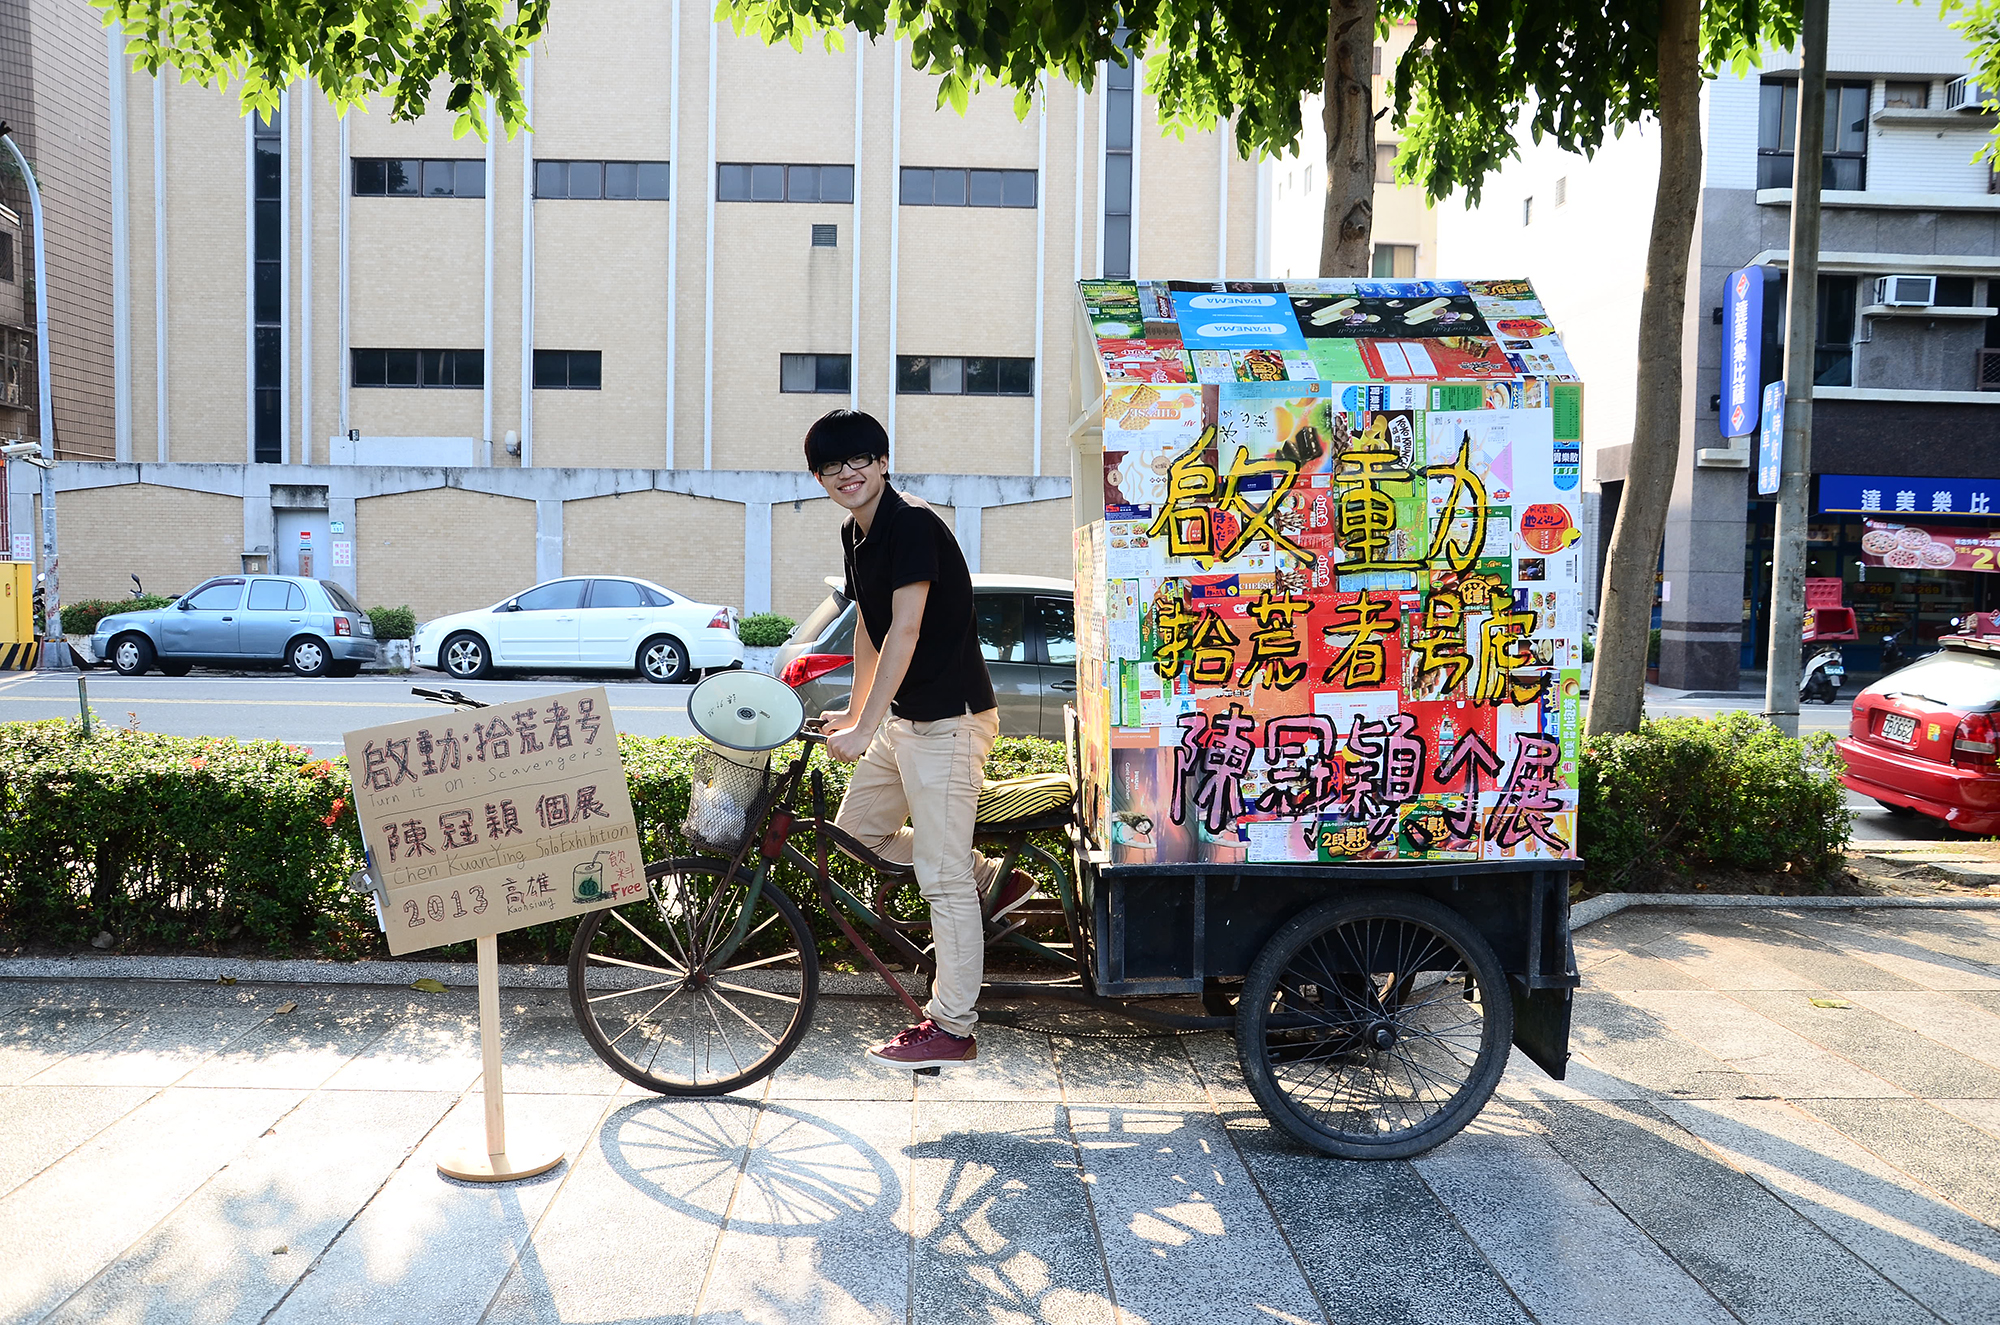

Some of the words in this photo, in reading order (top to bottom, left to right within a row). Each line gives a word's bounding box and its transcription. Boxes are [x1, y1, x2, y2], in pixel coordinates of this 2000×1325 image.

[368, 793, 400, 808] Turn
[412, 786, 425, 798] it
[488, 746, 603, 782] Scavengers
[393, 865, 438, 885] Chen
[445, 843, 527, 876] Kuan-Ying
[403, 884, 489, 929] 2013
[501, 872, 558, 905] 高雄
[507, 897, 556, 916] Kaohsiung
[610, 882, 643, 901] Free
